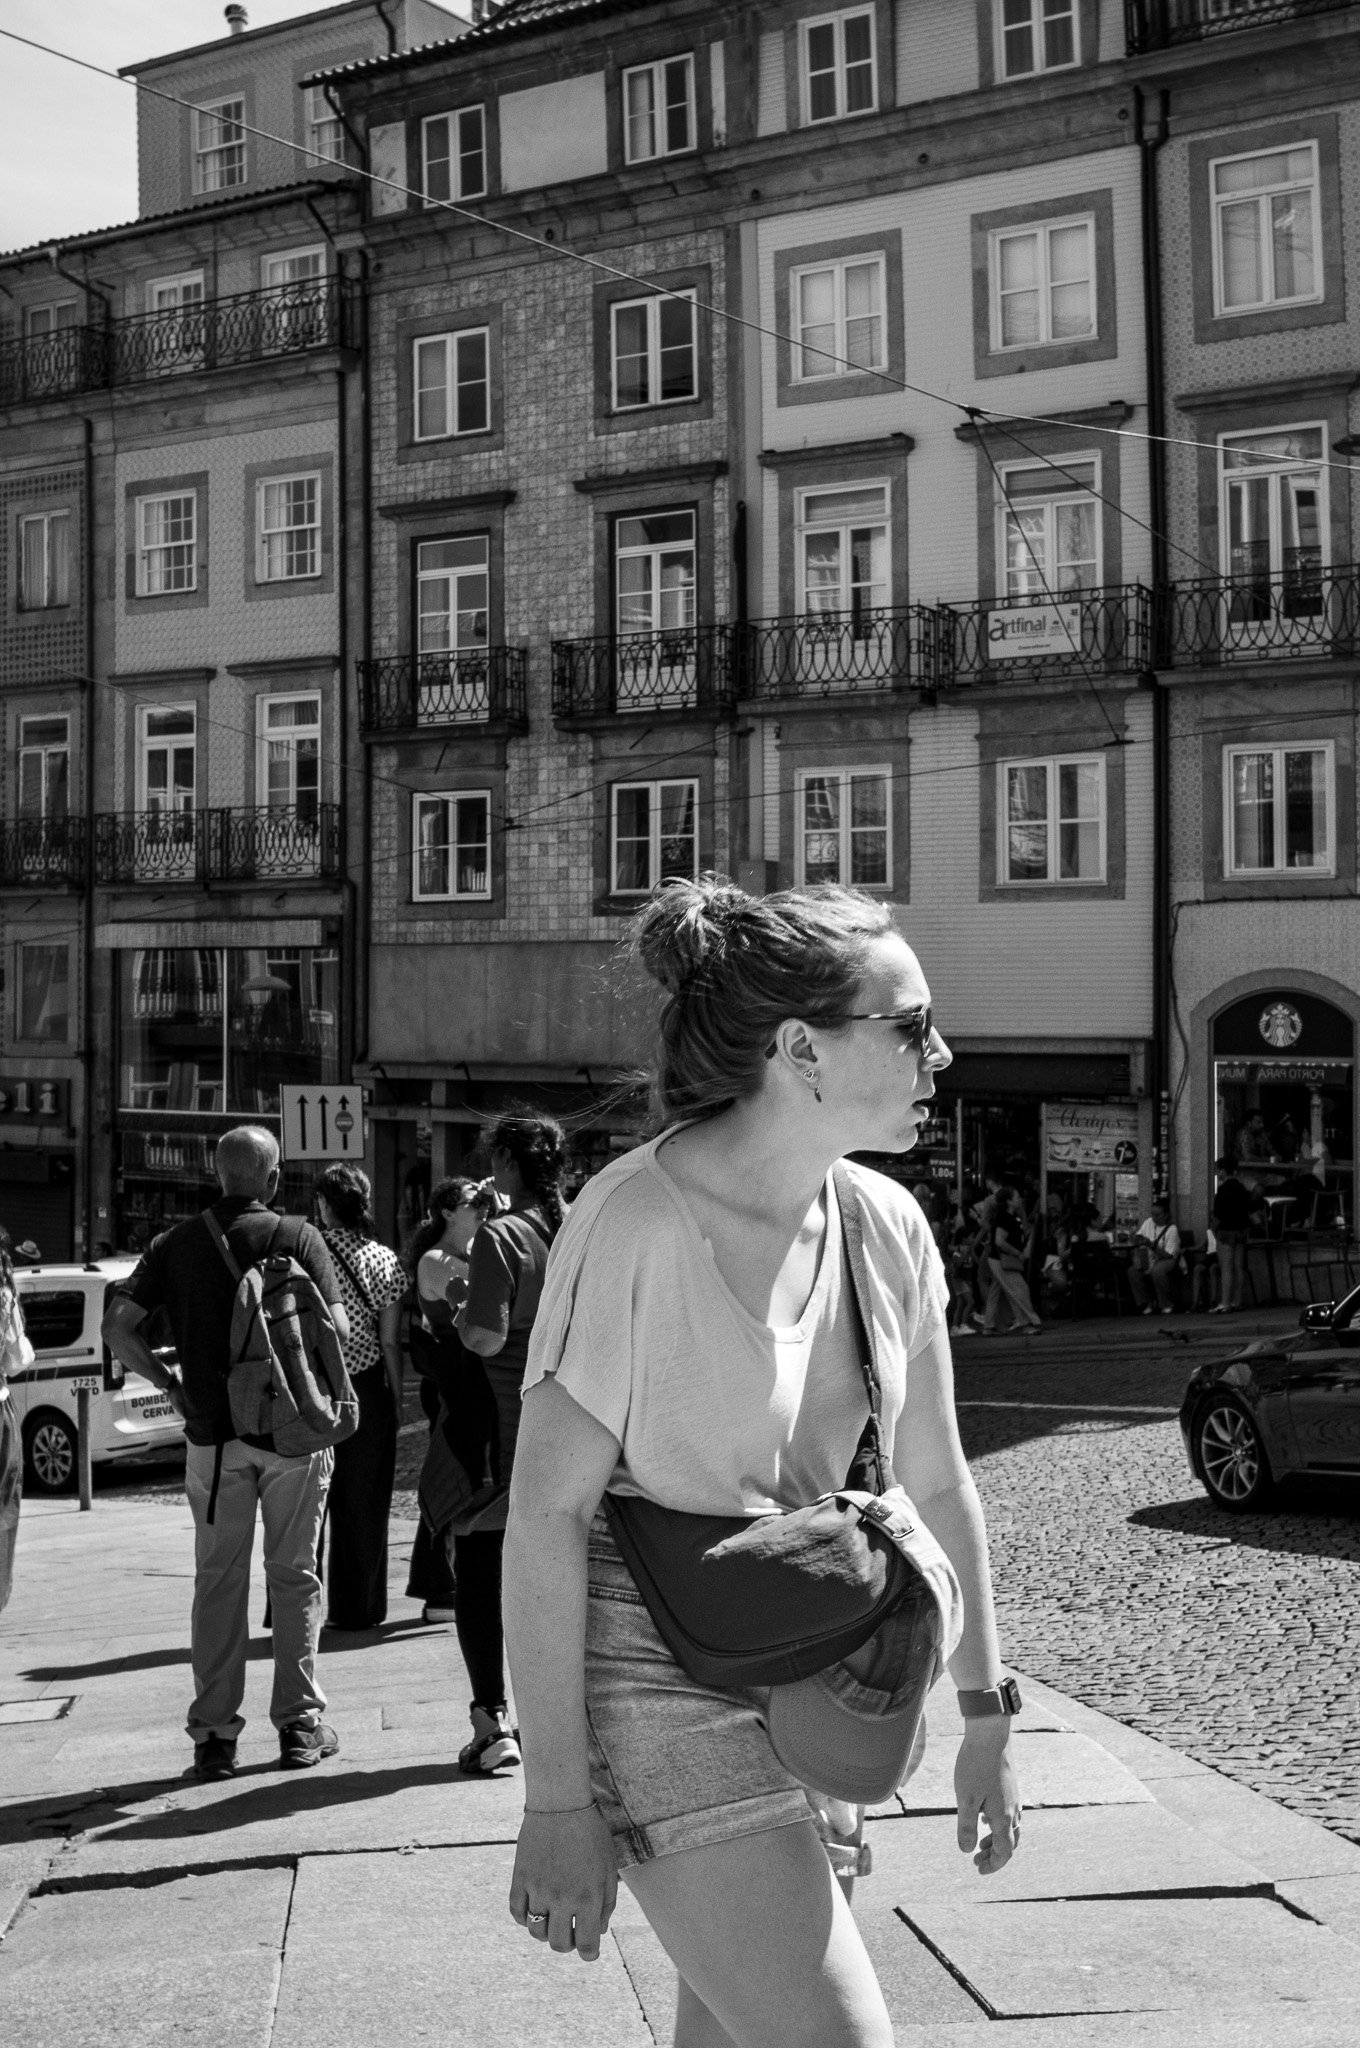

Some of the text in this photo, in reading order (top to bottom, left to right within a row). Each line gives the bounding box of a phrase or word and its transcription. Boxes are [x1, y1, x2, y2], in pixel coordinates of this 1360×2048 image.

[989, 615, 1047, 641] artfinal
[72, 1377, 97, 1388] 1725
[142, 1405, 175, 1419] CERVA
